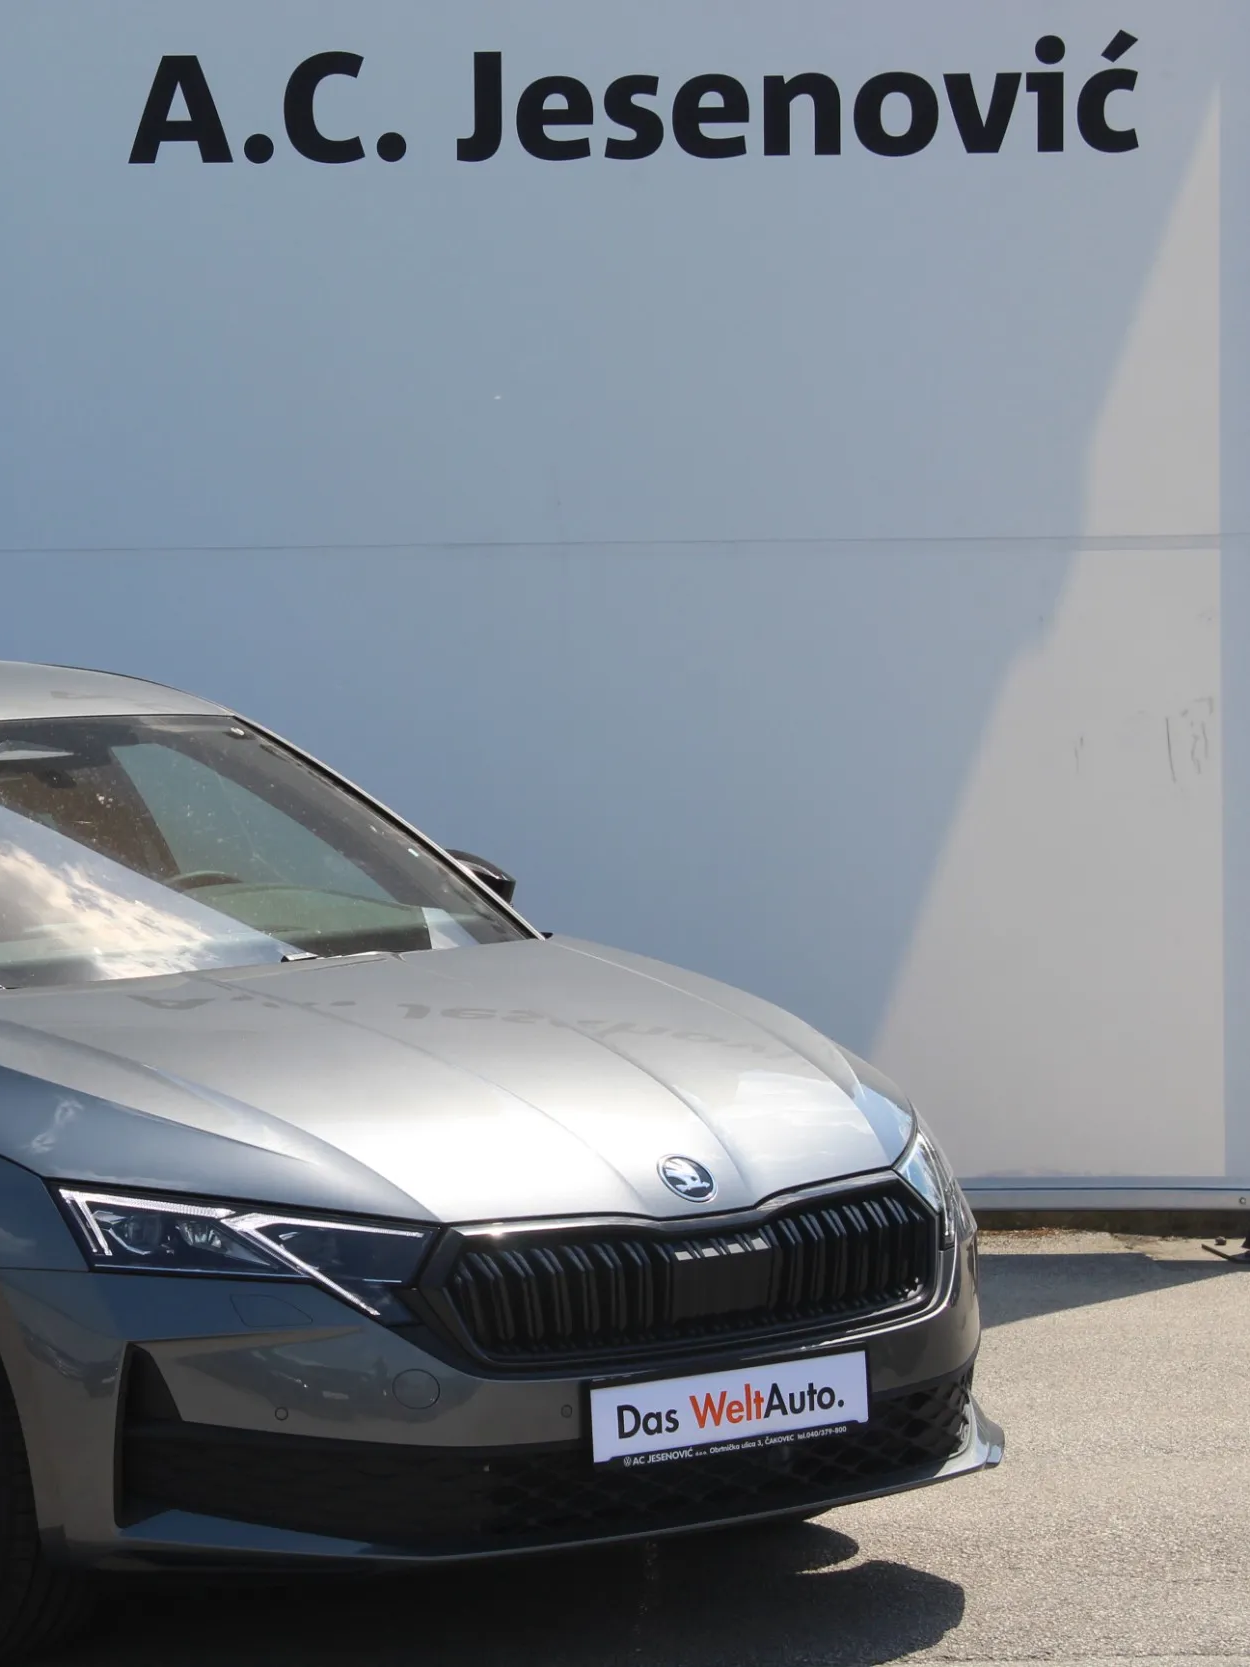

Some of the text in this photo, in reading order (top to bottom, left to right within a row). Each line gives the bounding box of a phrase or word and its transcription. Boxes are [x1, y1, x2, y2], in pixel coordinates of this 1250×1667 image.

[128, 29, 1139, 164] A.C. Jesenović
[616, 1382, 845, 1440] Das WeltAuto.
[632, 1456, 646, 1466] AC
[647, 1447, 694, 1464] JESENOVIĆ
[764, 1434, 795, 1445] ČAKOVEC
